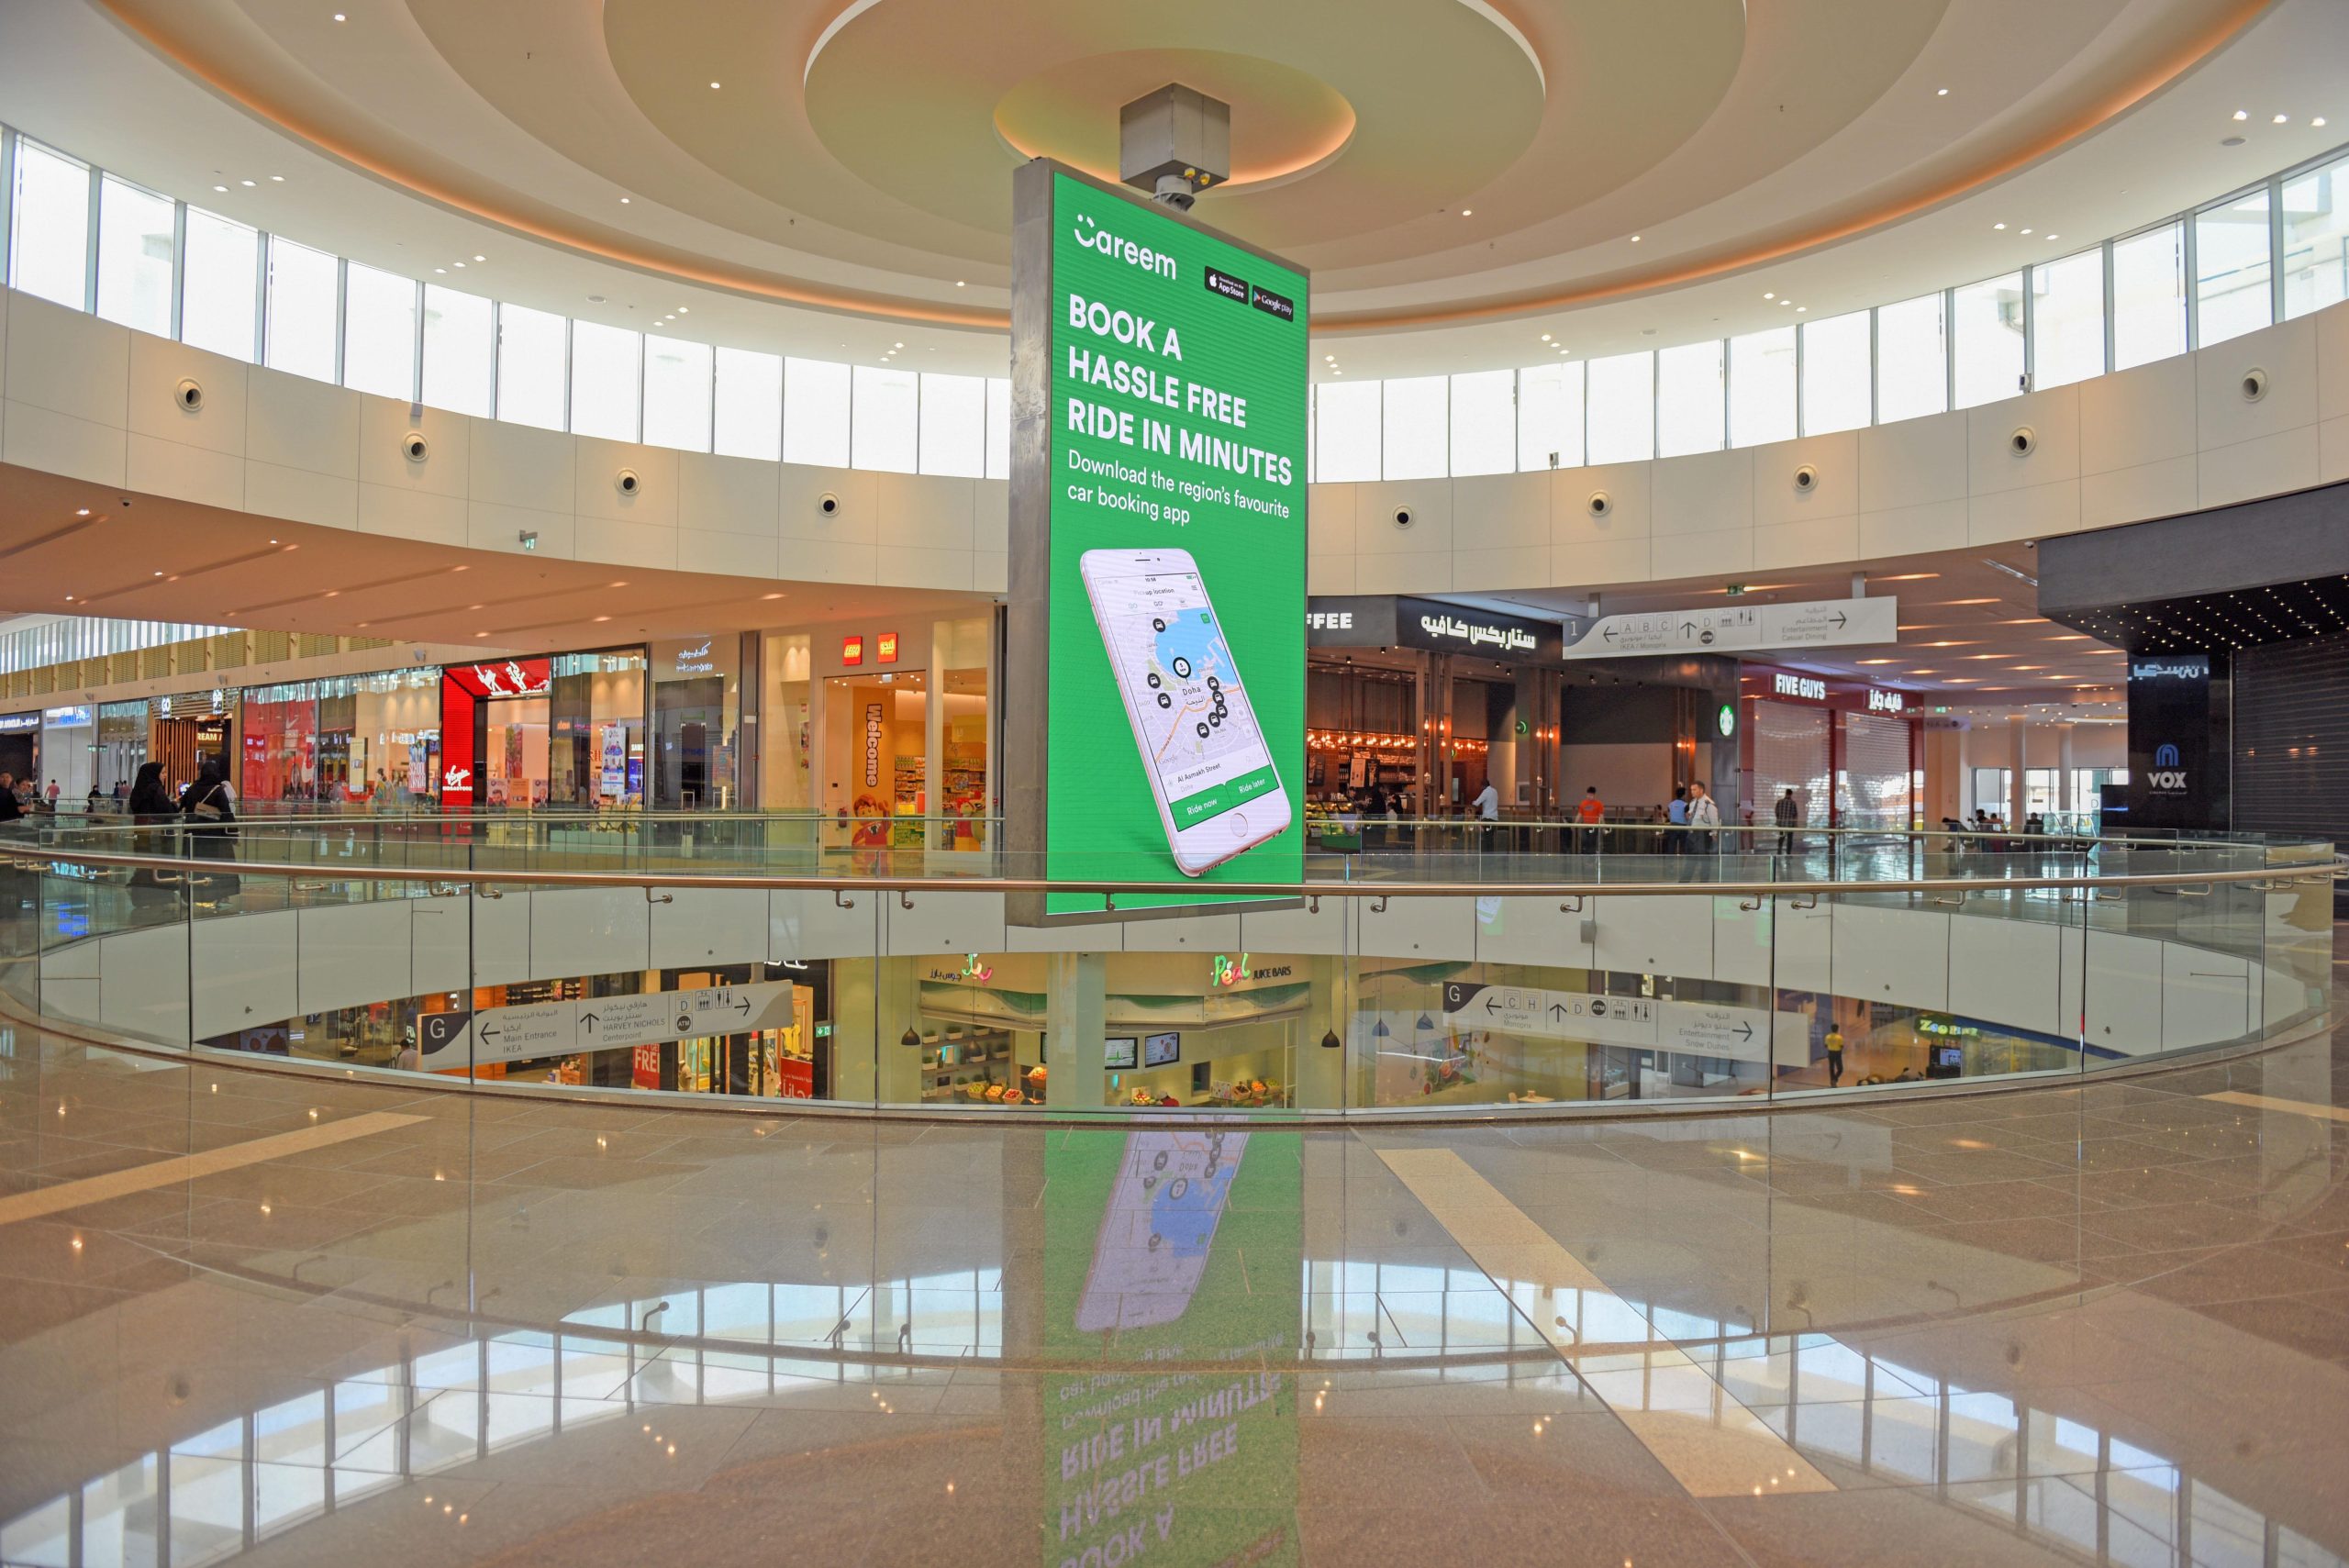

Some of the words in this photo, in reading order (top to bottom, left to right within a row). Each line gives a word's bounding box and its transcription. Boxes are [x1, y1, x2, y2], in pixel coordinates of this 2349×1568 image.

[1074, 214, 1176, 281] Careem
[1219, 282, 1230, 294] App
[1230, 286, 1244, 298] Store
[1262, 295, 1282, 311] Google
[1282, 304, 1292, 316] play
[1070, 294, 1155, 352] BOOK
[1162, 328, 1183, 361] A
[1069, 345, 1179, 409] HASSLE
[1187, 382, 1246, 428] FREE
[1068, 397, 1134, 446] RIDE
[1142, 417, 1171, 455] IN
[1180, 428, 1292, 486] MINUTES
[1068, 449, 1147, 485] Download
[1152, 470, 1174, 492] the
[1178, 480, 1230, 506] region's
[1234, 489, 1289, 518] favourite
[1067, 484, 1093, 503] car
[1097, 485, 1159, 521] booking
[1163, 505, 1190, 527] app
[1570, 621, 1577, 637] 1
[1625, 623, 1631, 632] A
[1643, 622, 1649, 631] B
[1661, 620, 1668, 629] C
[1704, 617, 1711, 627] D
[1782, 624, 1828, 633] Entertainment
[1782, 633, 1803, 641] Casual
[1806, 632, 1827, 640] Dining
[844, 645, 862, 657] LEGO
[1183, 687, 1201, 695] Doha
[1776, 673, 1798, 695] FIVE
[1799, 678, 1825, 700] GUYS
[866, 704, 883, 787] Welcome
[1185, 769, 1205, 780] Asmakh
[1205, 762, 1220, 772] Street
[1239, 784, 1252, 794] Ride
[1252, 778, 1265, 788] later
[2147, 771, 2187, 789] VOX
[1186, 804, 1203, 815] Ride
[1204, 798, 1218, 809] now
[1273, 966, 1291, 977] BARS
[1448, 985, 1460, 1002] G
[681, 1001, 687, 1011] D
[1508, 997, 1515, 1007] C
[1529, 998, 1536, 1010] H
[1575, 1004, 1582, 1015] D
[429, 1018, 445, 1039] G
[603, 1020, 631, 1031] HARVEY
[634, 1018, 665, 1029] NICHOLS
[1504, 1019, 1531, 1029] Monoprix
[504, 1033, 522, 1043] Main
[524, 1030, 557, 1041] Entrance
[603, 1031, 641, 1042] Centerpoint
[1679, 1028, 1730, 1040] Entertainment
[504, 1045, 522, 1054] IKEA
[1686, 1039, 1704, 1049] Snow
[1707, 1041, 1730, 1051] Dunes
